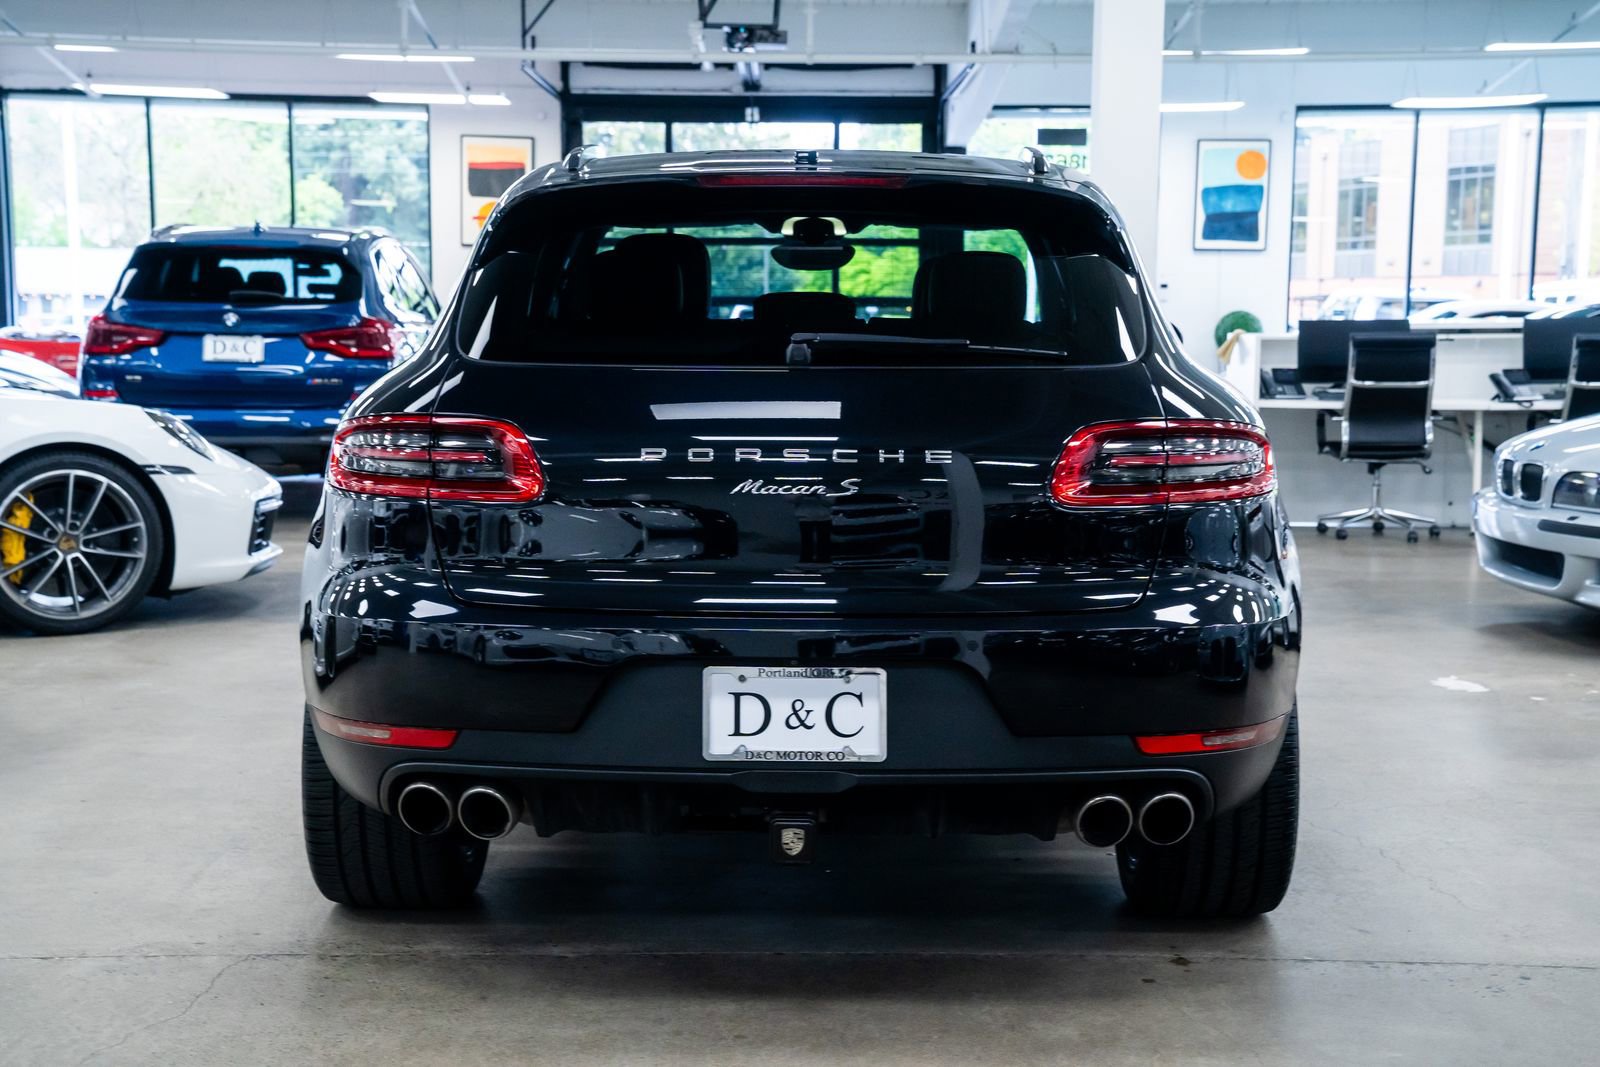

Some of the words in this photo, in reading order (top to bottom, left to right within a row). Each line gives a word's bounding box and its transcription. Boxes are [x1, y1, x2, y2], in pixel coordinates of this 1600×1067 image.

[213, 340, 226, 355] D
[243, 340, 257, 355] C
[641, 447, 953, 463] PORSCHE
[729, 479, 827, 495] Macan
[826, 478, 862, 497] S
[758, 667, 807, 679] Portland
[727, 692, 772, 737] D
[785, 699, 816, 730] &
[825, 691, 864, 738] C
[745, 751, 773, 761] D&C
[776, 751, 823, 761] MOTOR
